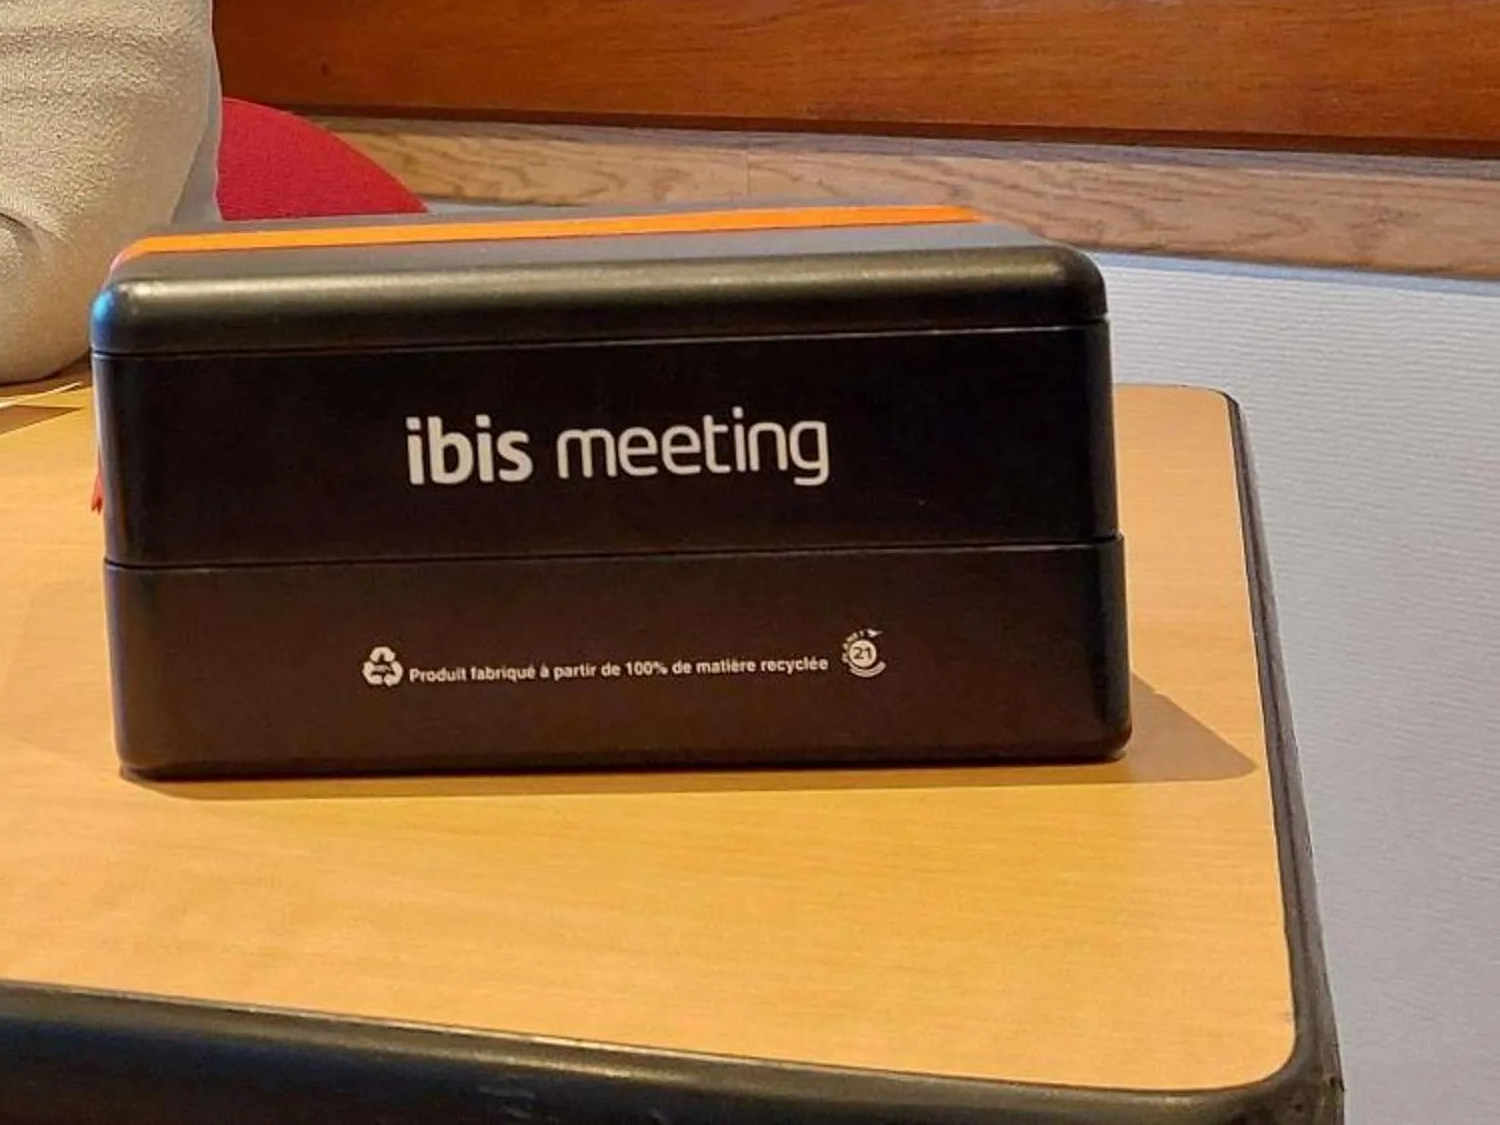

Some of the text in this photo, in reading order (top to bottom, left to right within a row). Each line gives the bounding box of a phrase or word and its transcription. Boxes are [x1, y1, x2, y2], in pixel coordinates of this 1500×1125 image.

[405, 406, 830, 487] ibis meeting
[852, 645, 873, 660] 21
[409, 667, 467, 683] Produit
[470, 663, 536, 683] fabriqué
[539, 661, 550, 678] à
[553, 663, 597, 681] partir
[601, 660, 621, 676] de
[626, 660, 669, 676] 100%
[672, 659, 692, 675] de
[696, 658, 758, 674] matière
[760, 657, 829, 675] recyclée
